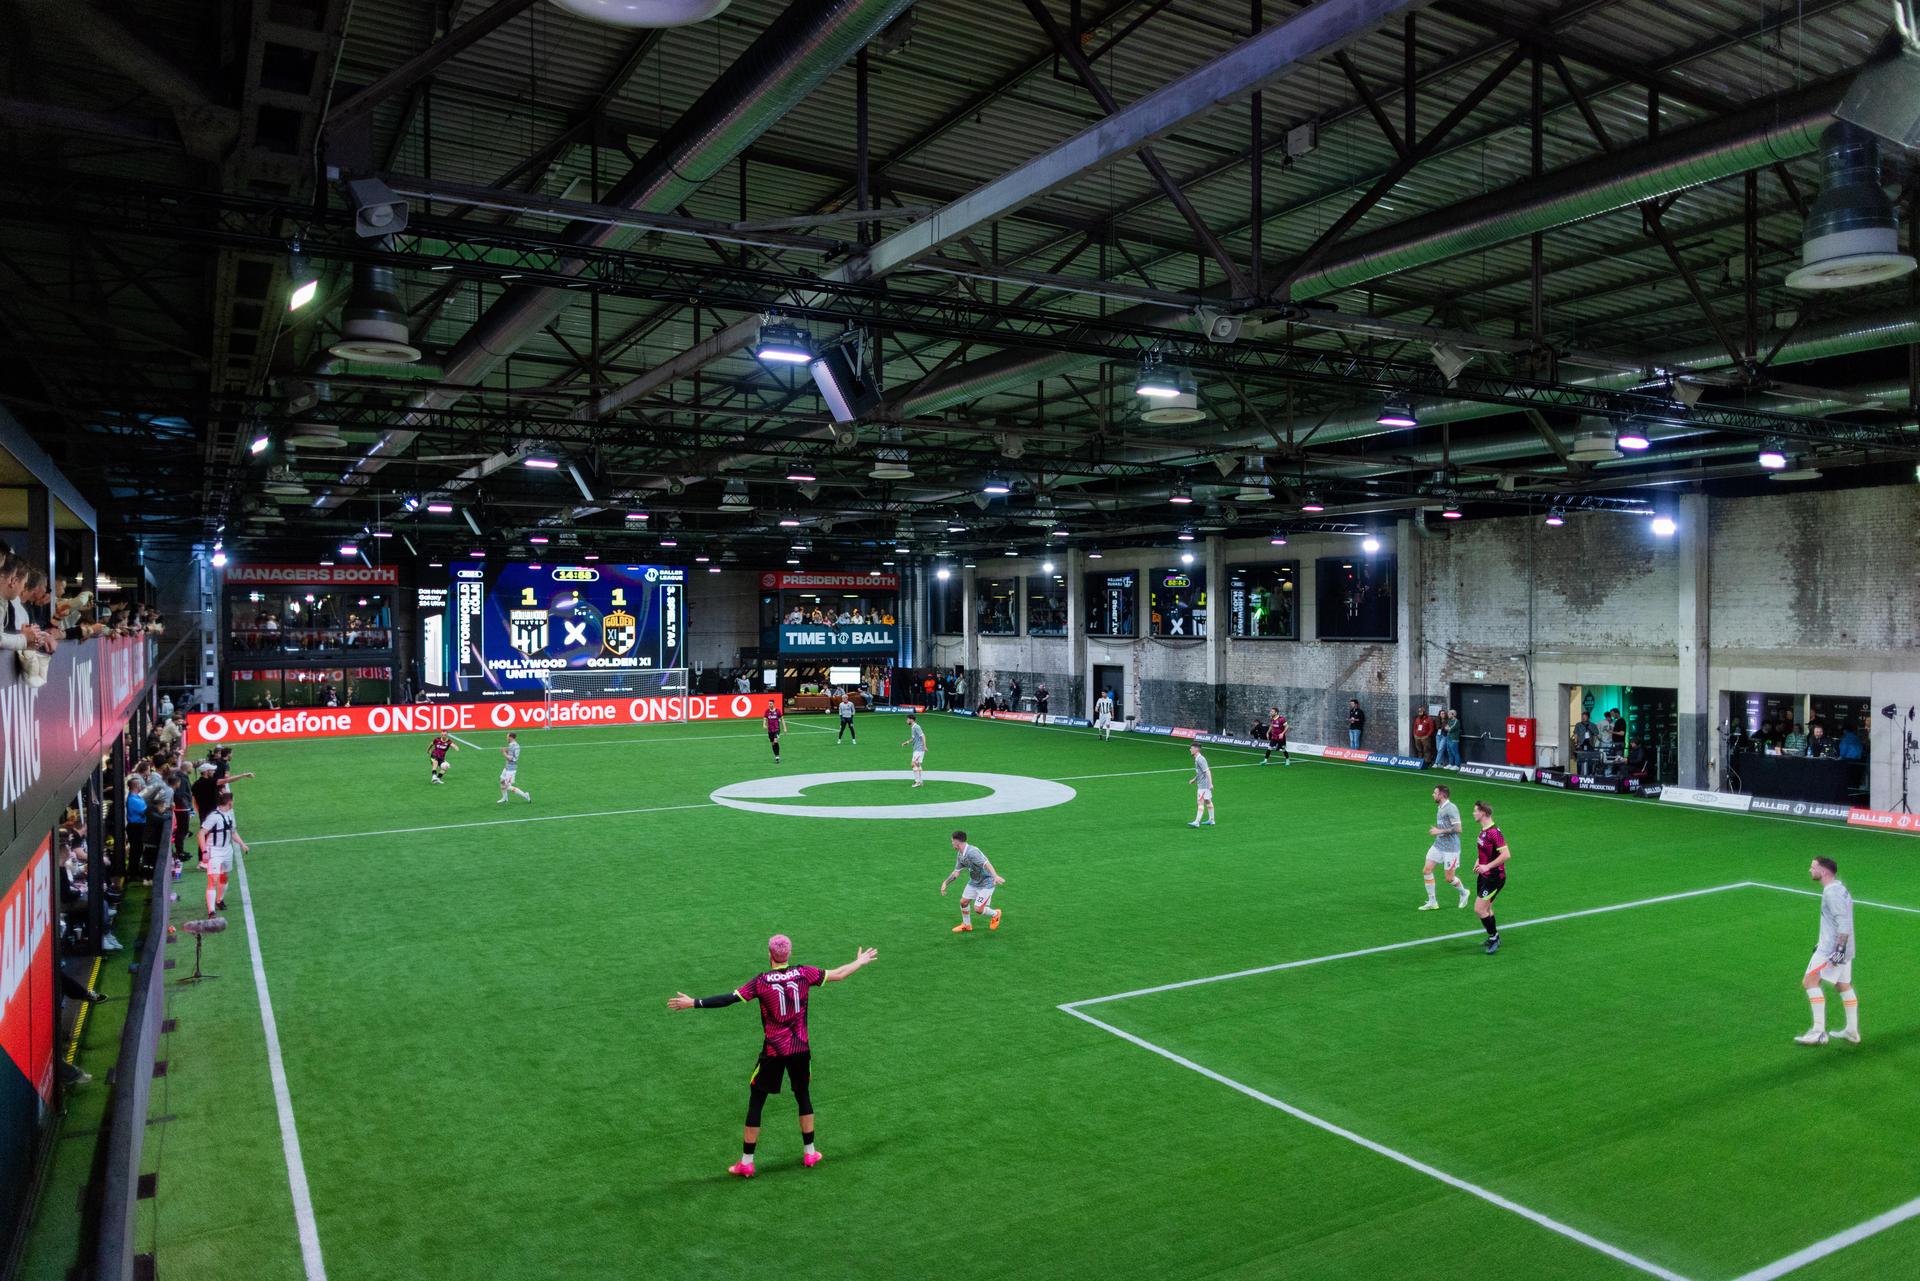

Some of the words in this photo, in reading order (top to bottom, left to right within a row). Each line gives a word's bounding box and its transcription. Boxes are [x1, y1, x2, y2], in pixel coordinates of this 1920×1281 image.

[227, 569, 330, 580] MANAGERS
[334, 569, 394, 581] BOOTH
[783, 575, 854, 585] PRESIDENTS
[857, 577, 895, 585] BOOTH
[522, 588, 537, 605] 1
[612, 588, 626, 606] 1
[460, 584, 470, 664] MOTORWORLD
[605, 616, 633, 626] GOLDEN
[667, 597, 676, 647] SPIELTAG
[607, 629, 617, 639] XI
[786, 632, 825, 645] TIME
[852, 632, 893, 644] BALL
[489, 659, 567, 669] HOLLYWOOD
[587, 658, 637, 667] GOLDEN
[639, 657, 651, 666] XI
[506, 669, 550, 679] UNITED
[76, 658, 94, 738] XING
[520, 703, 616, 722] vodafone
[630, 697, 718, 721] ONSIDE
[234, 711, 351, 735] vodafone
[368, 705, 475, 732] ONSIDE
[1, 676, 41, 810] XING
[1368, 755, 1388, 763] BALLER
[1460, 766, 1484, 775] BALLER
[1495, 771, 1521, 779] LEAGUE
[1579, 776, 1594, 784] TVN
[1752, 801, 1789, 811] BALLER
[1809, 807, 1848, 817] LEAGUE
[1851, 812, 1893, 823] BALLER
[0, 849, 50, 1021] ALLER
[772, 981, 800, 1016] 11
